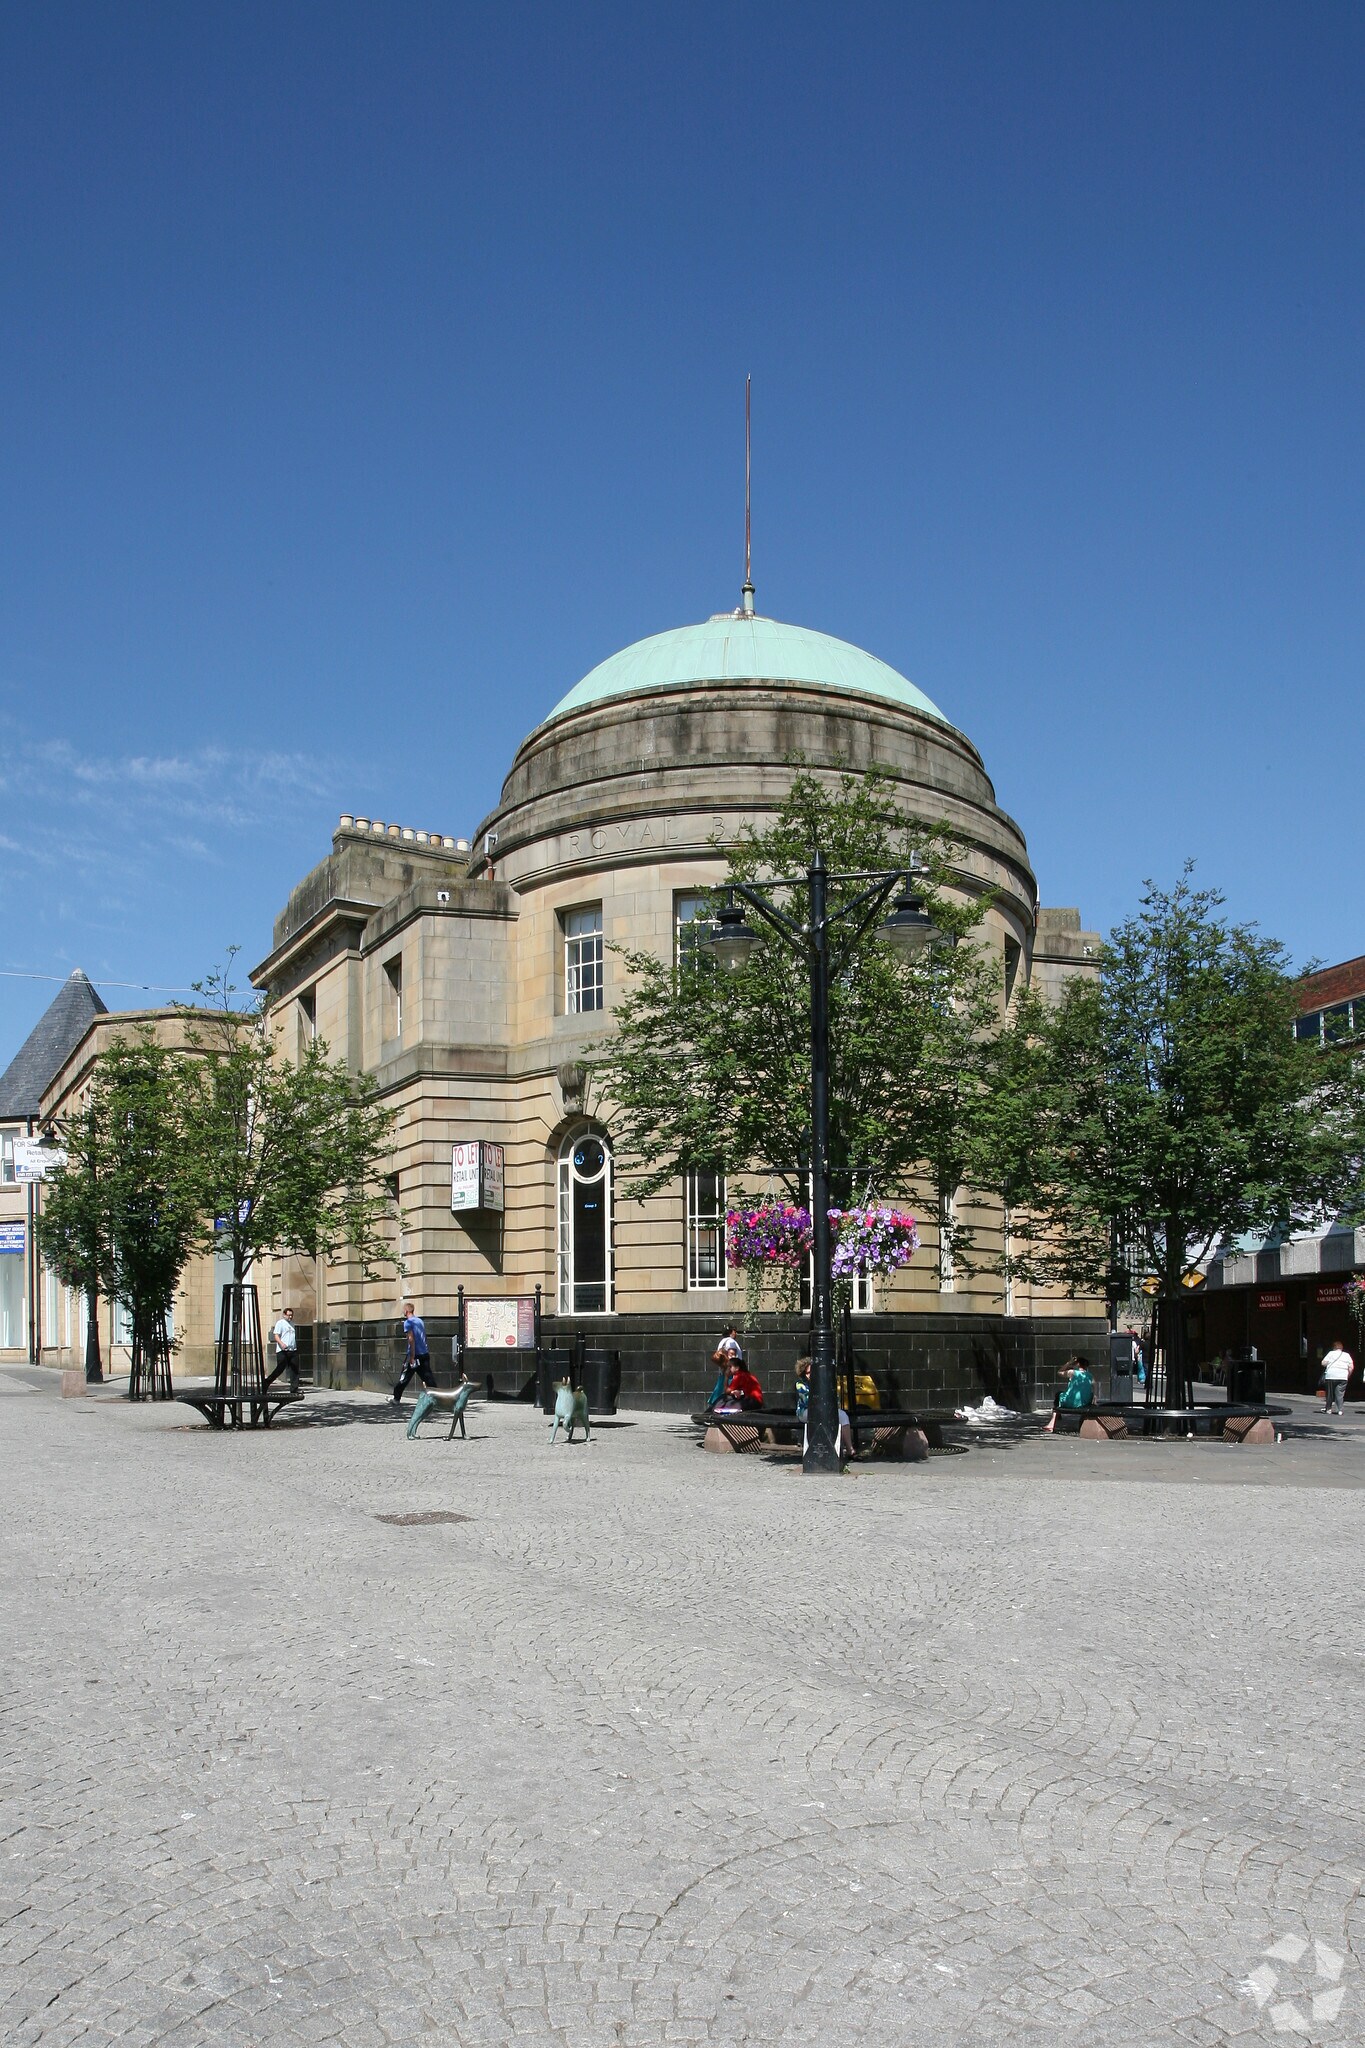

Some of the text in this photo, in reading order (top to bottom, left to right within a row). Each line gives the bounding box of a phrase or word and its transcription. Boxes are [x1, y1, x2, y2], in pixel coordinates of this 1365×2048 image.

[569, 818, 679, 856] ROYAL
[14, 1140, 26, 1148] FOR
[453, 1144, 479, 1167] TO LET
[484, 1143, 503, 1168] TO LET
[453, 1167, 479, 1182] RETAIL UNIT
[484, 1168, 496, 1182] RETAIL
[1318, 1288, 1344, 1296] NOBLES
